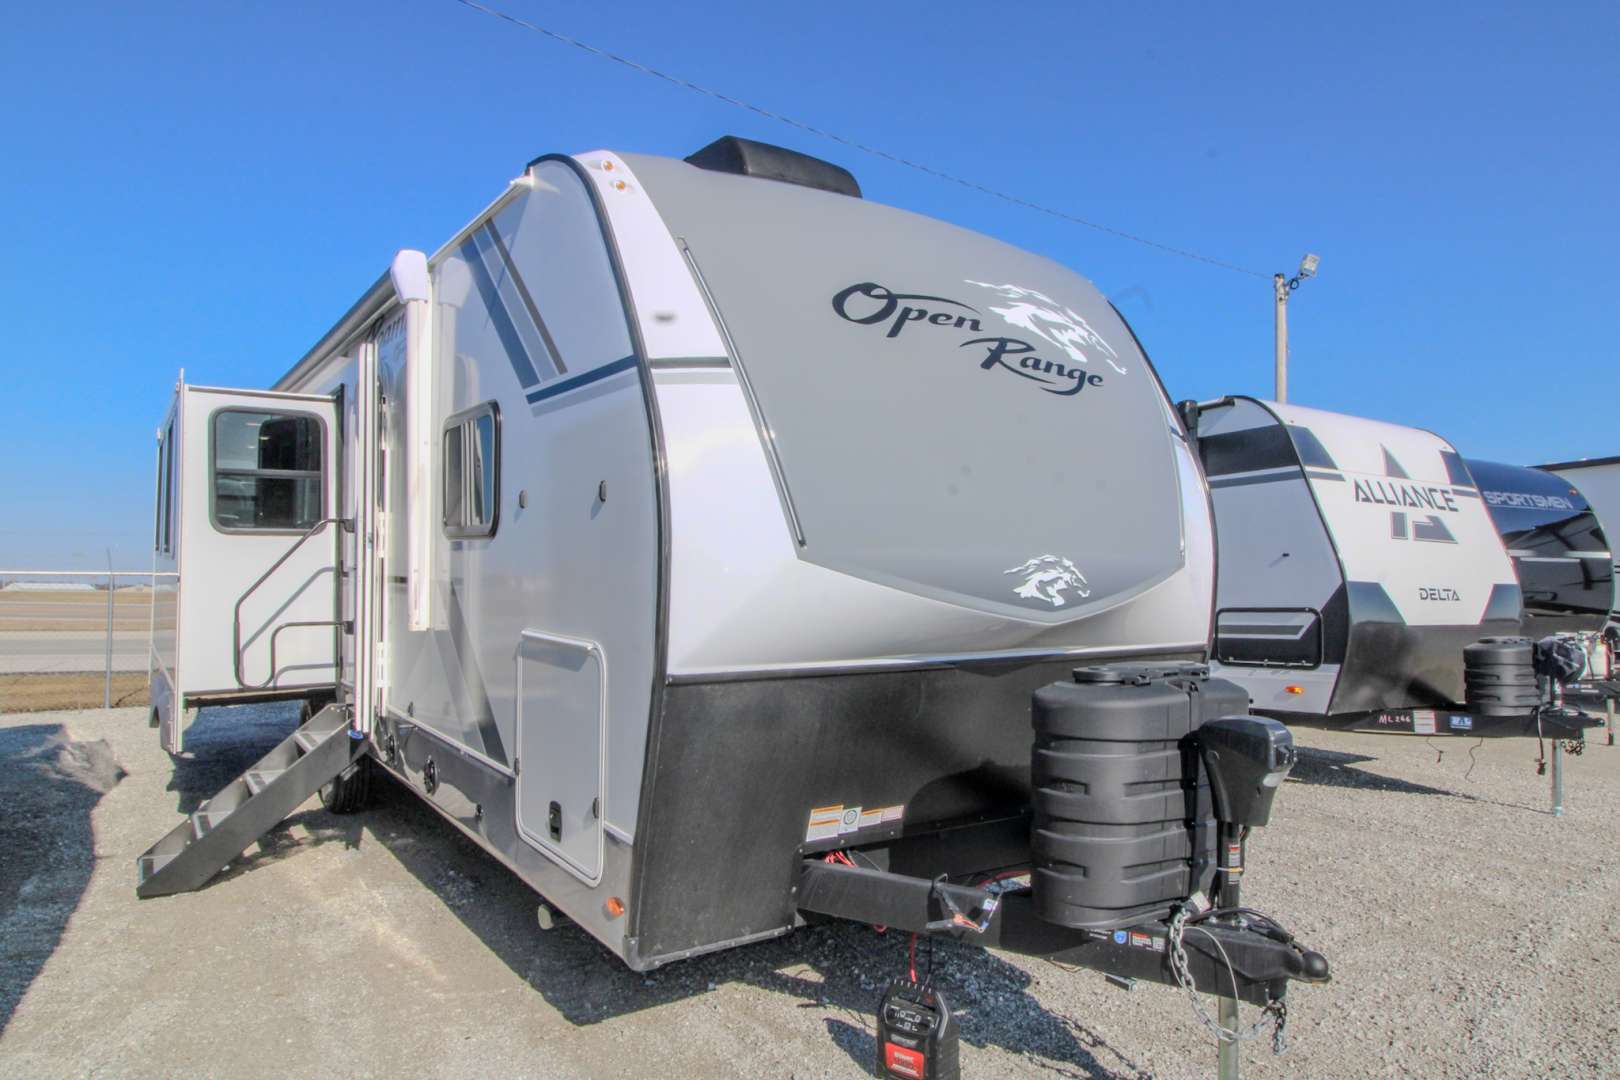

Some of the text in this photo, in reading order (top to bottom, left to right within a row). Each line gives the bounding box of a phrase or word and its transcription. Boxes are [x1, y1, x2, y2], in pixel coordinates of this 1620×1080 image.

[832, 282, 983, 338] Open
[960, 337, 1104, 396] Range
[1354, 479, 1459, 512] ALLIANCE
[1484, 491, 1573, 510] SPORTSMEN
[1419, 587, 1460, 601] DELTA
